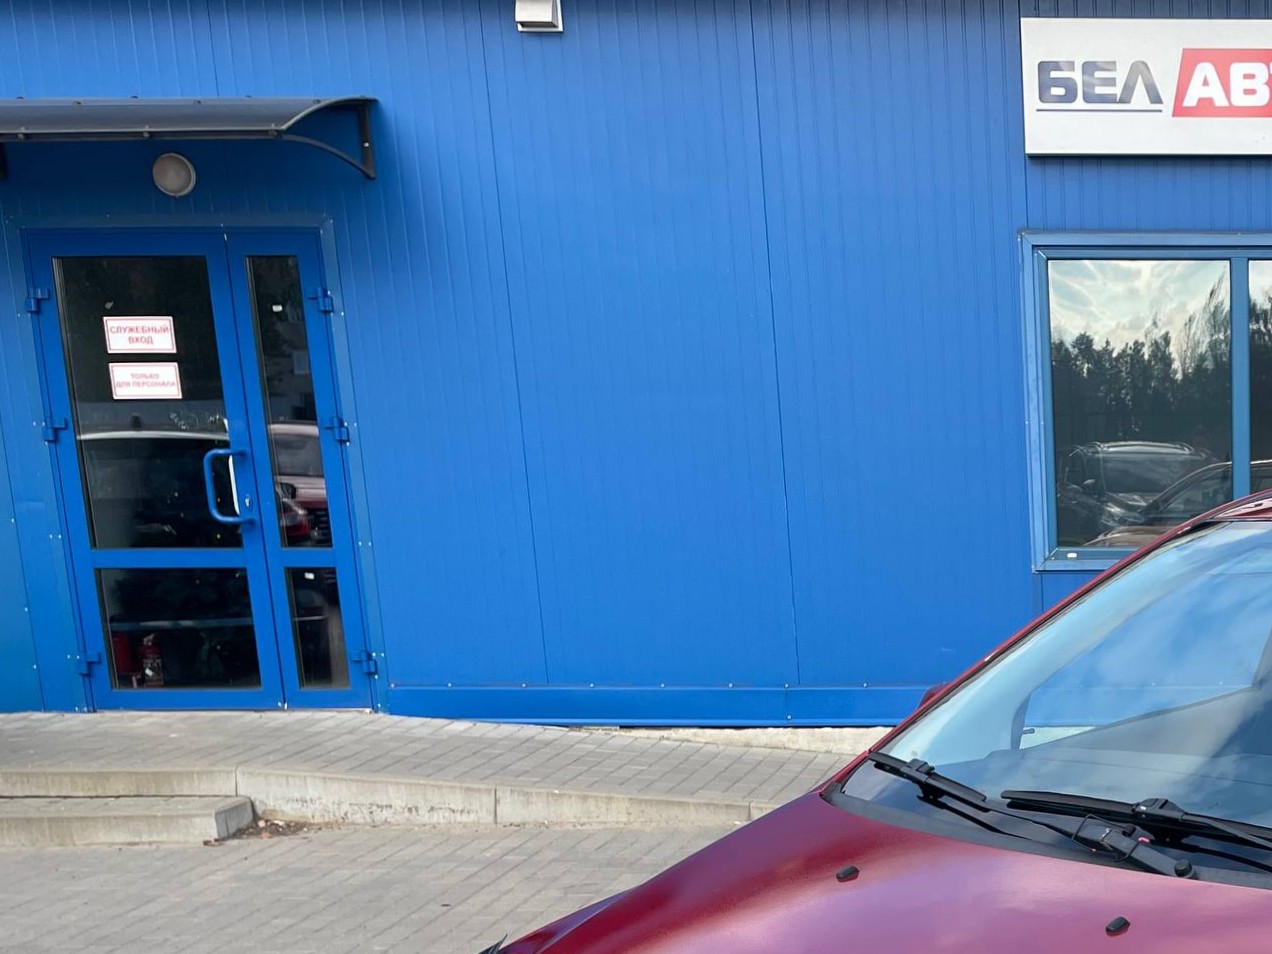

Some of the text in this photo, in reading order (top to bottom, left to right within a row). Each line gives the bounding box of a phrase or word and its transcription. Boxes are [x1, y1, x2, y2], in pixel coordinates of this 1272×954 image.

[1036, 60, 1164, 105] БЕЛ
[109, 324, 170, 335] СЛУЖЕБНЫЙ
[128, 336, 154, 345] ВХОД
